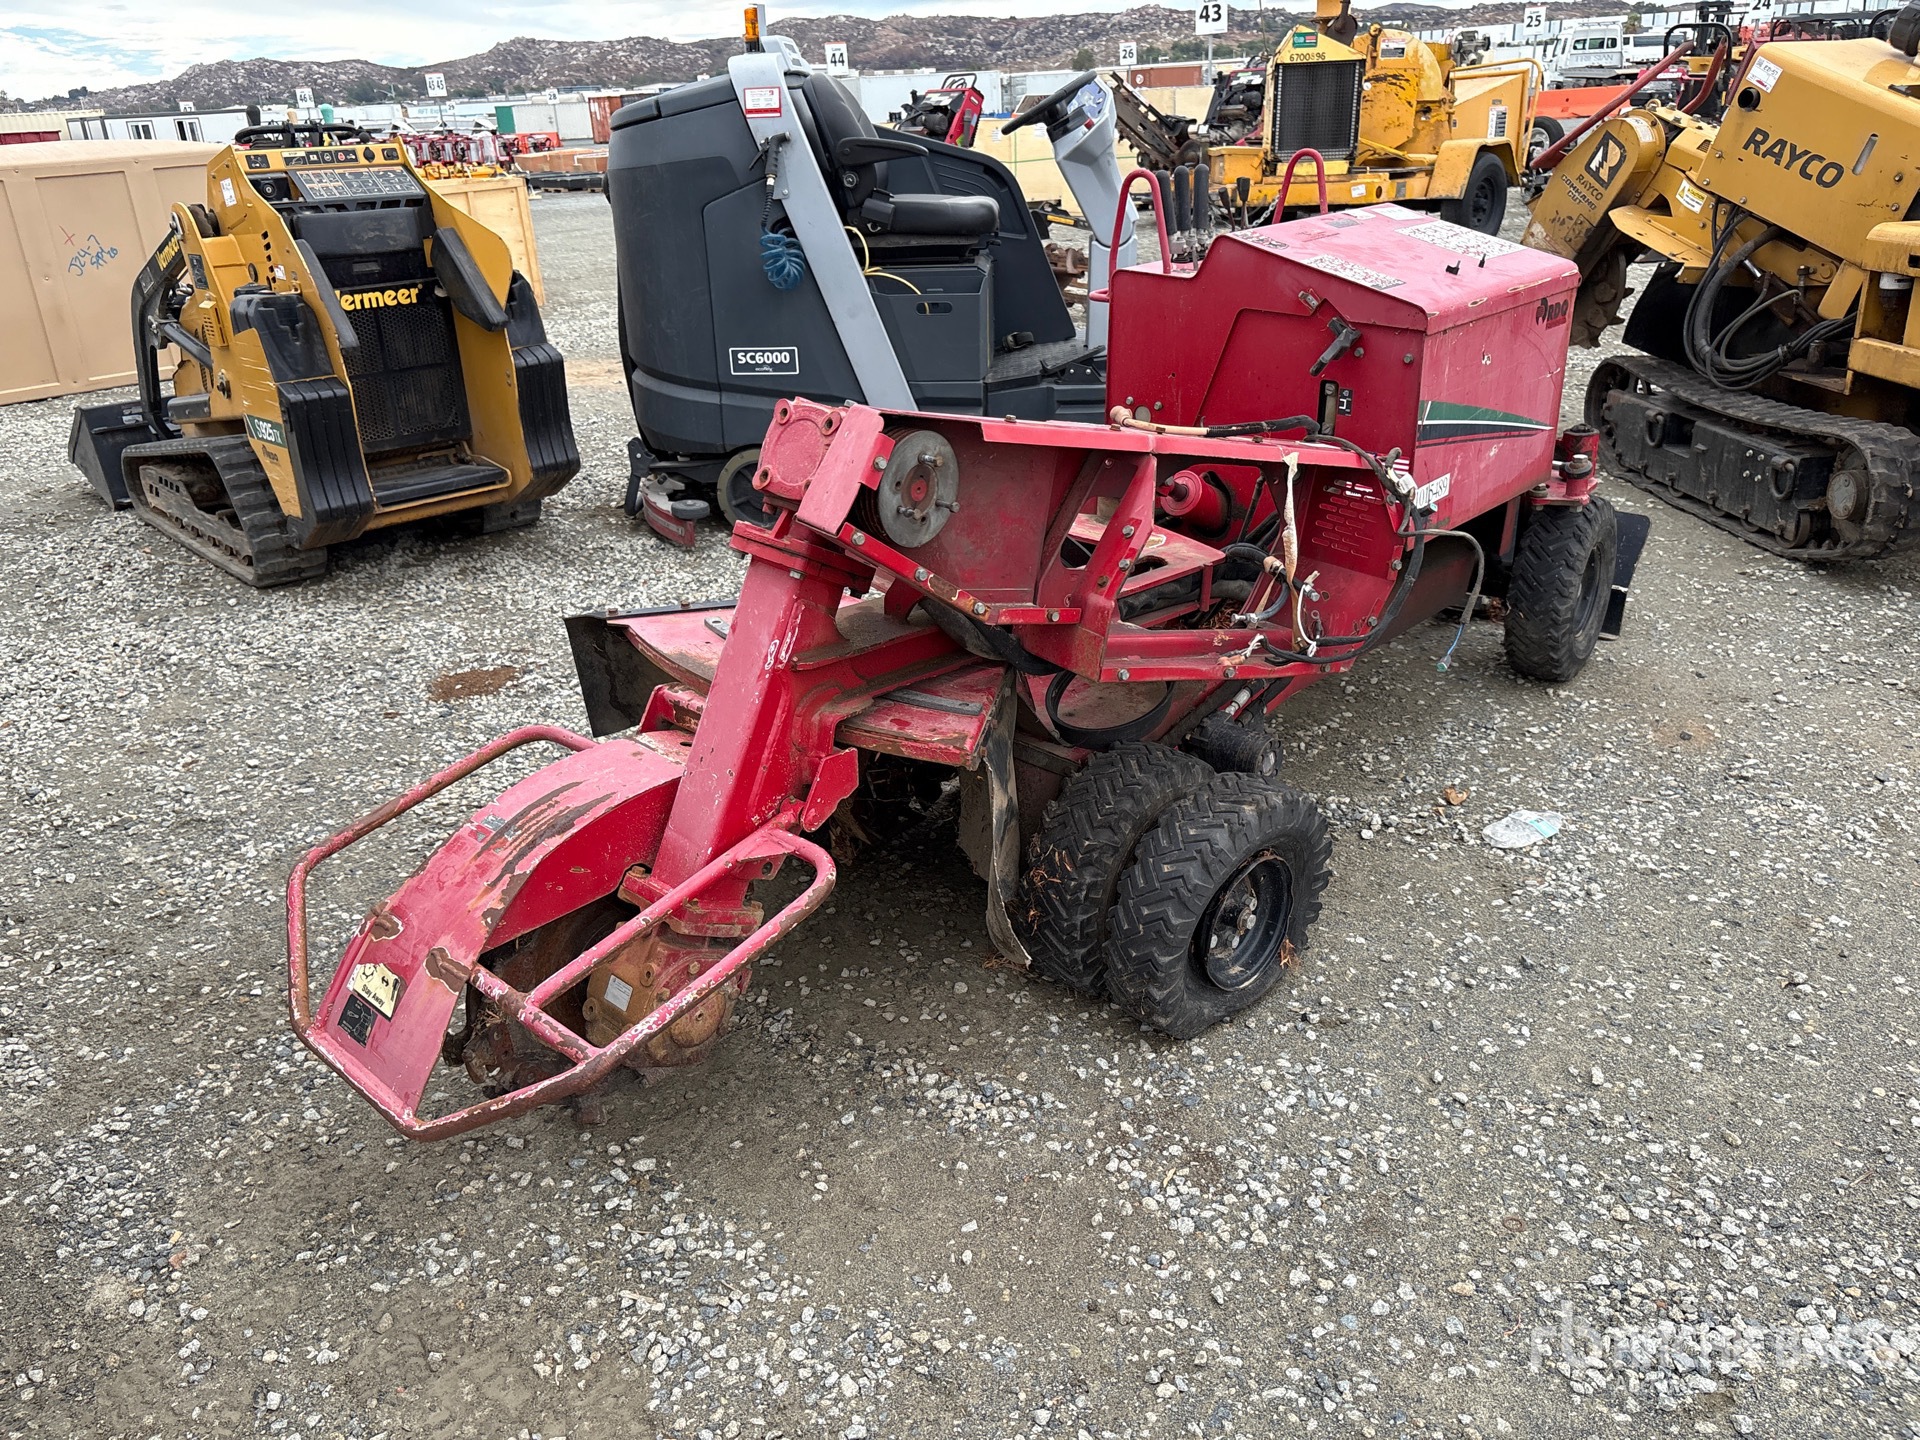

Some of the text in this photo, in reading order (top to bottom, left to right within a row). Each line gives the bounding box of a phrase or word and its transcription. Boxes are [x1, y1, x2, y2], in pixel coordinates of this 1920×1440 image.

[1752, 0, 1771, 10] 24
[1199, 4, 1221, 23] 43
[1525, 15, 1542, 28] 25
[830, 52, 845, 67] 44
[1122, 49, 1134, 59] 26
[299, 94, 308, 103] 46
[1742, 126, 1845, 189] RAYCO
[1561, 173, 1597, 211] COMMAND
[1576, 173, 1603, 202] RAYCO
[1567, 190, 1583, 205] CUT
[737, 352, 791, 365] SC6000
[361, 983, 373, 998] Stay
[372, 992, 386, 1008] Away
